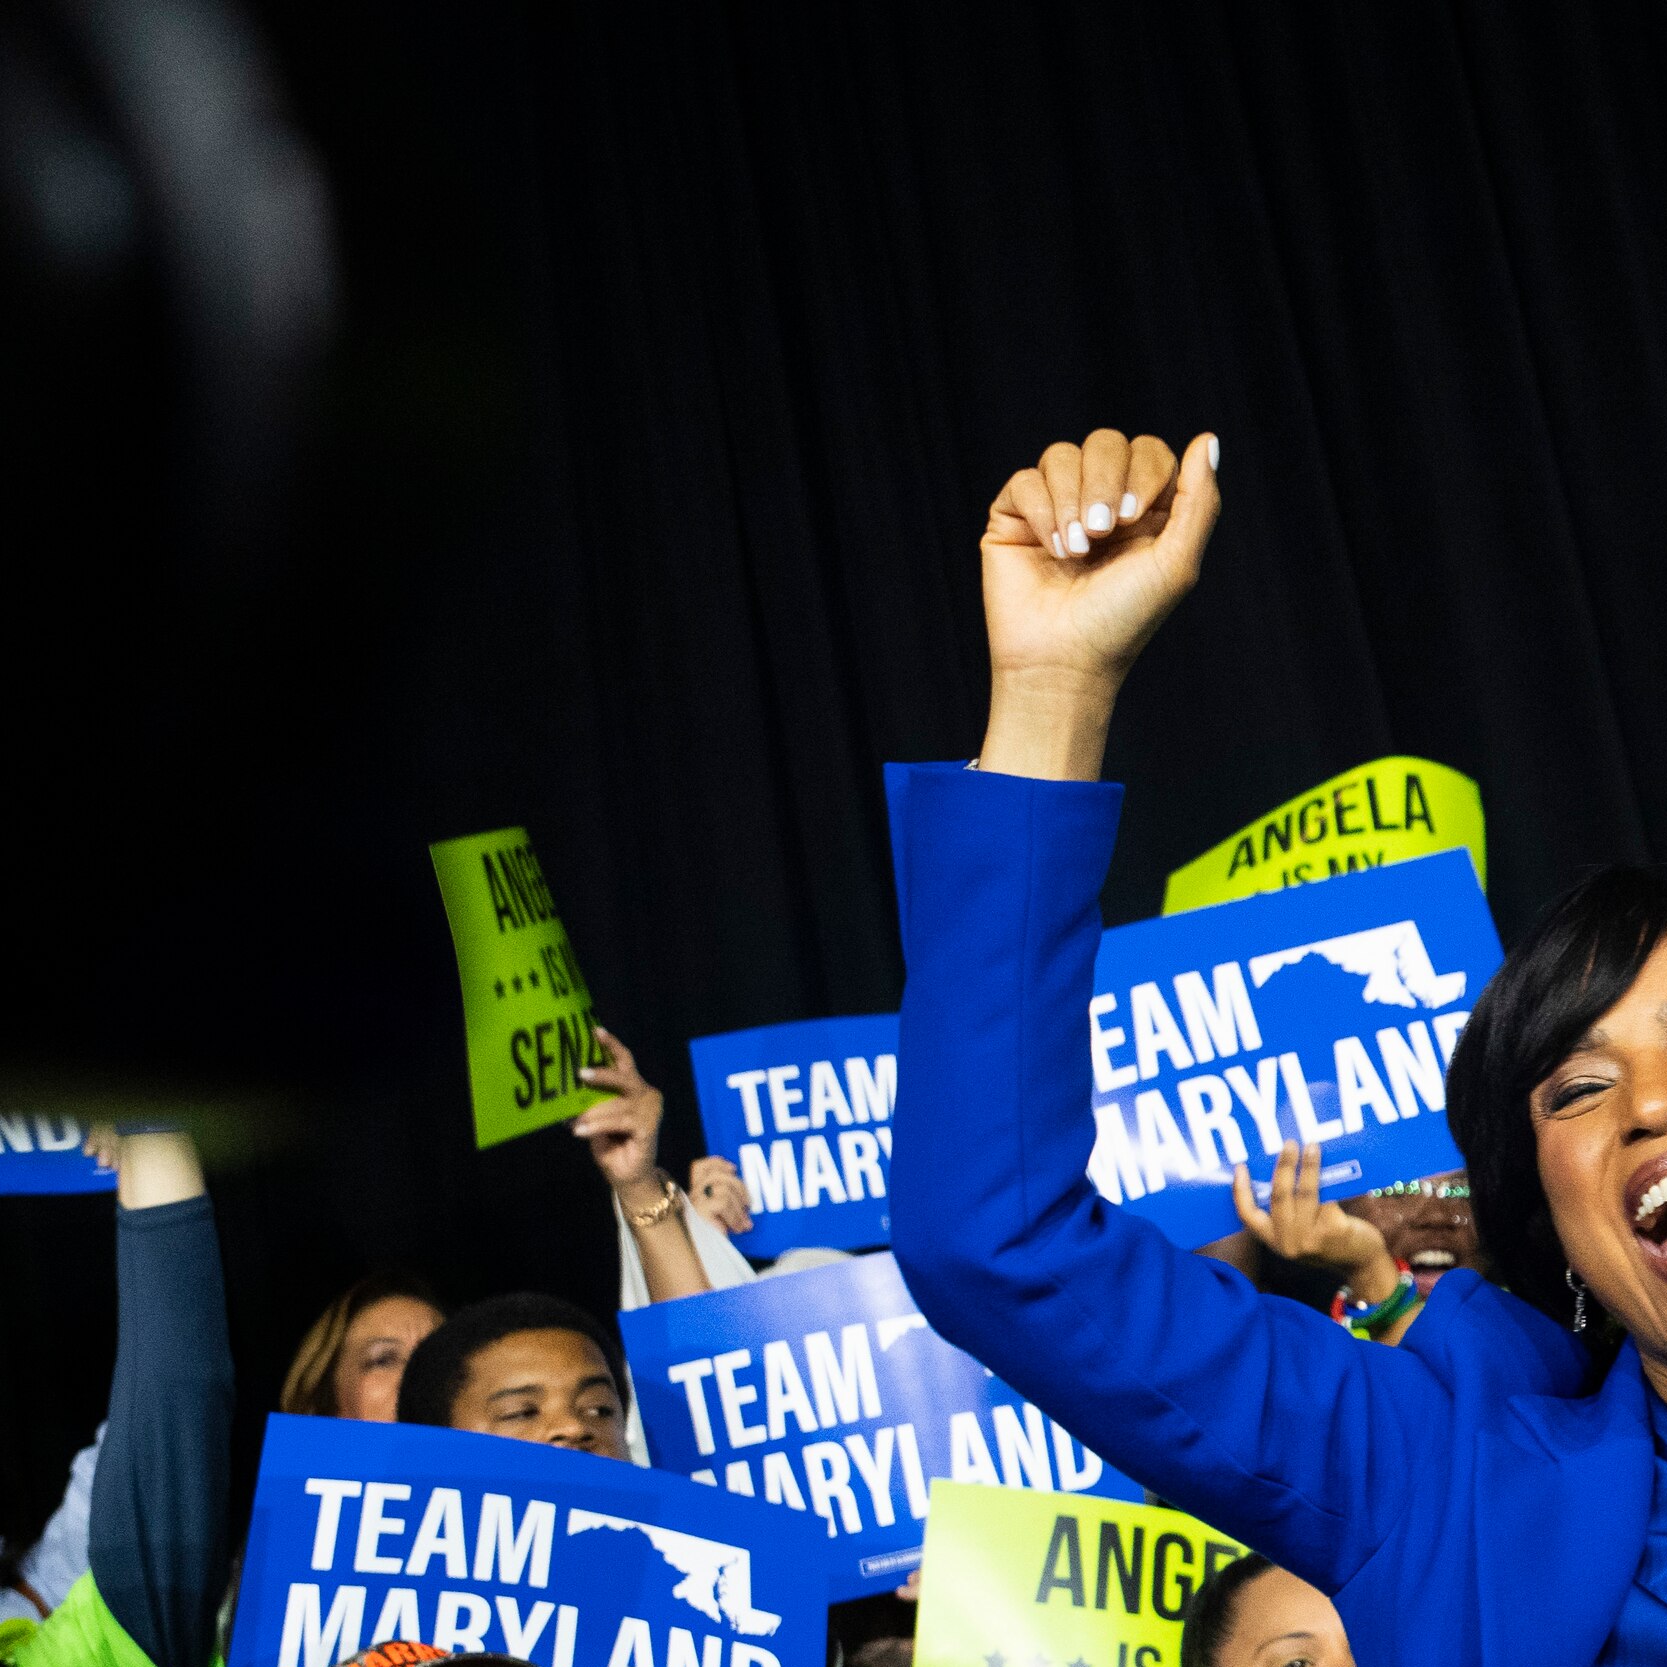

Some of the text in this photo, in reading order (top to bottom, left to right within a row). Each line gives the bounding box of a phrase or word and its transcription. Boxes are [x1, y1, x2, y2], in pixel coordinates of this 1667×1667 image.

[1228, 772, 1437, 881] ANGELA
[1090, 961, 1264, 1094] EAM
[726, 1053, 898, 1138] TEAM
[668, 1322, 883, 1457] TEAM
[304, 1476, 557, 1589] TEAM
